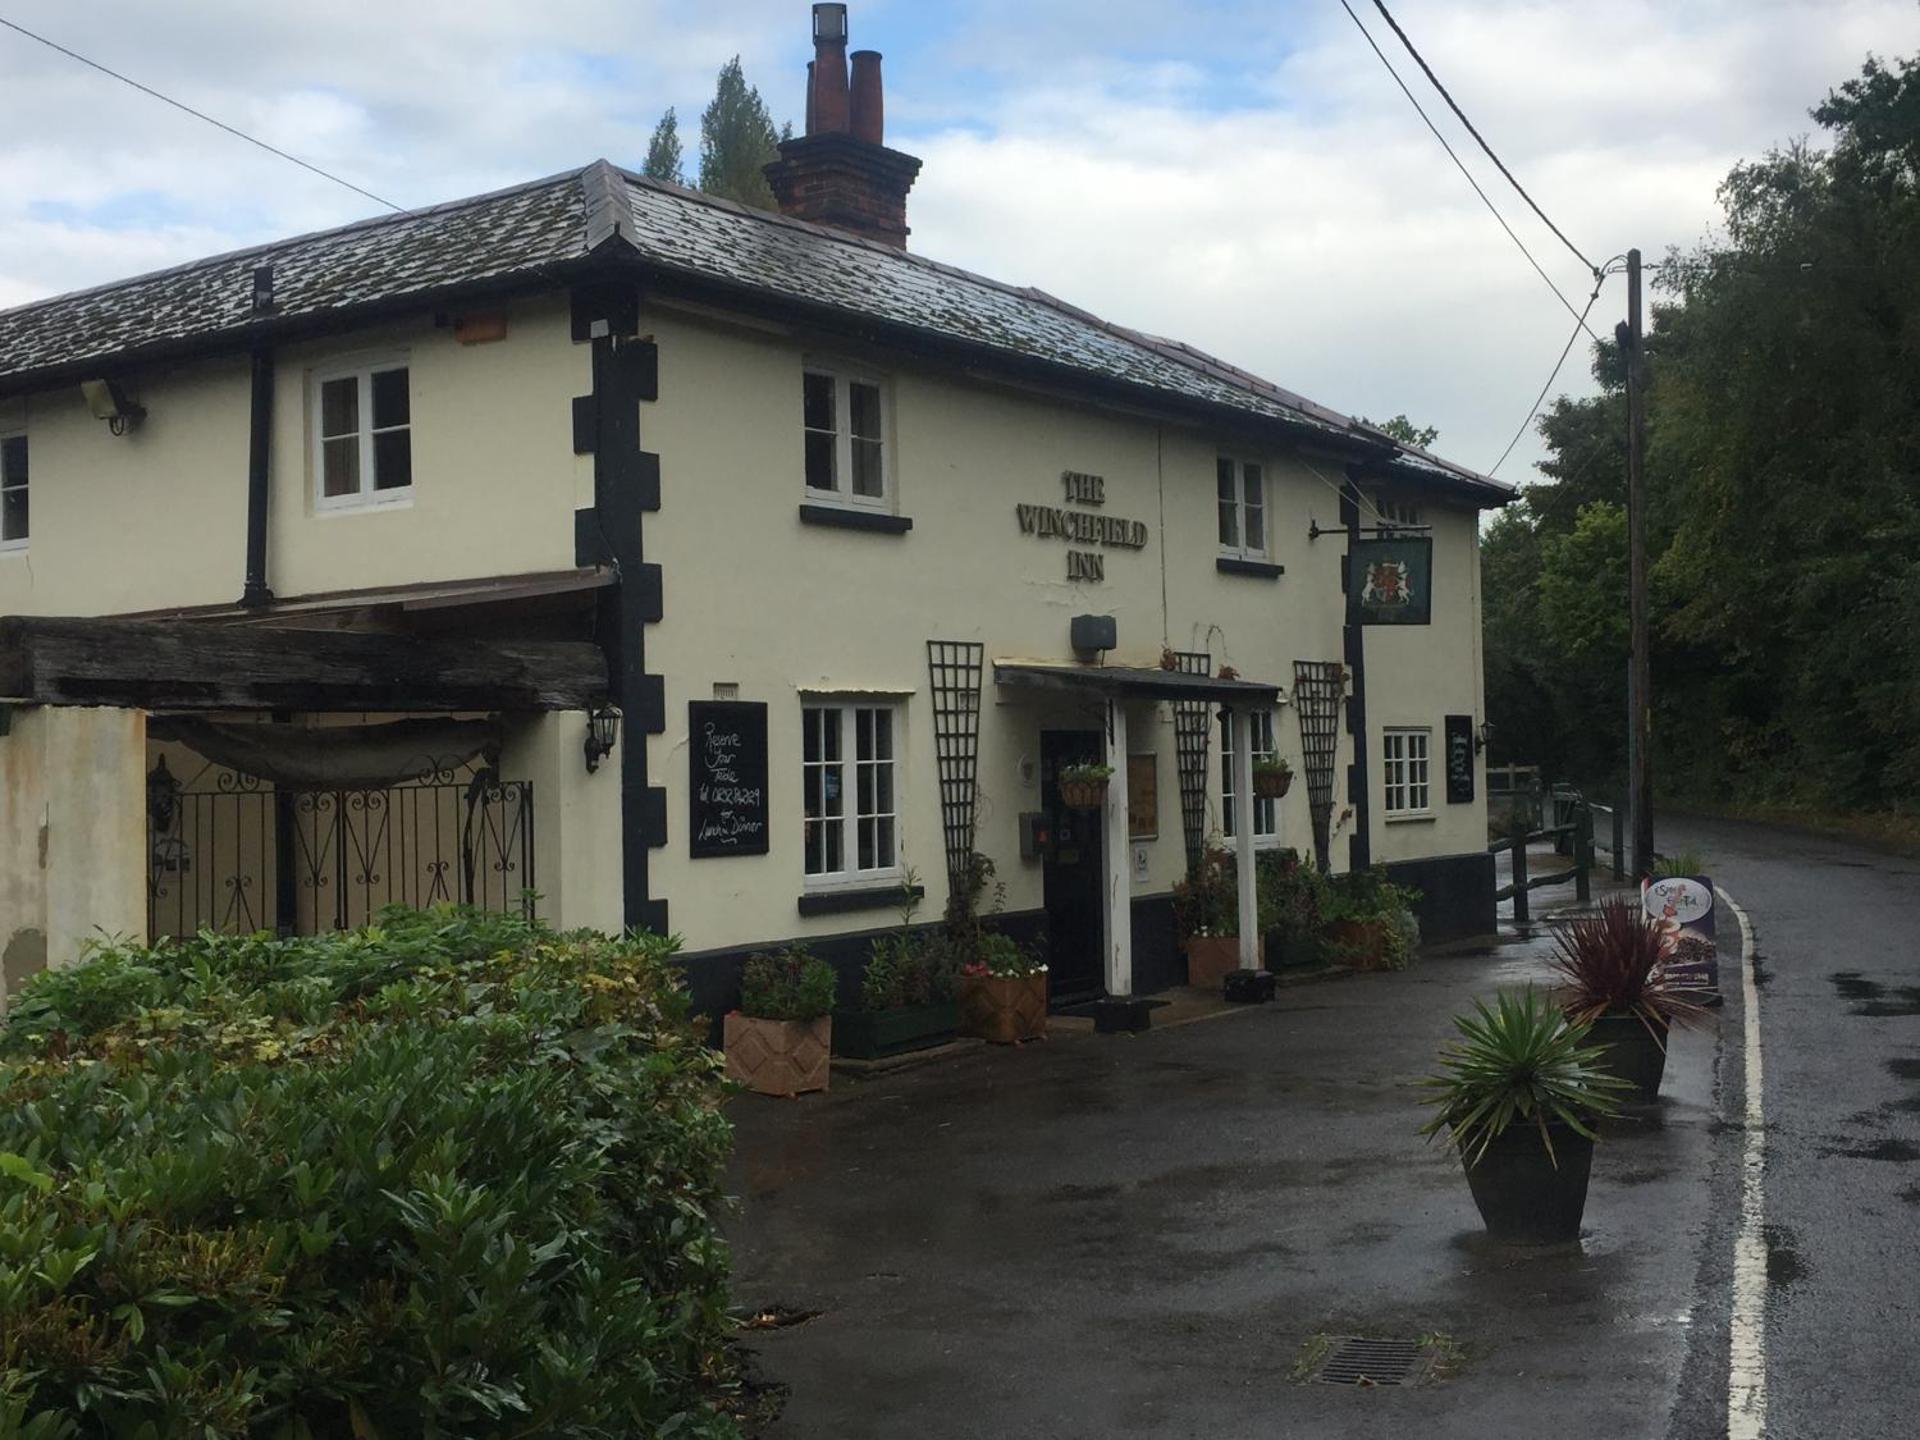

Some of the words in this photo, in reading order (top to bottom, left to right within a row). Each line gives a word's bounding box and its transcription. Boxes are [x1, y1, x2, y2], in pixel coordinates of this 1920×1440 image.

[1062, 470, 1105, 505] THE
[1016, 503, 1148, 550] WINCHFIELD
[1066, 550, 1104, 582] INN
[730, 815, 763, 836] Dinner
